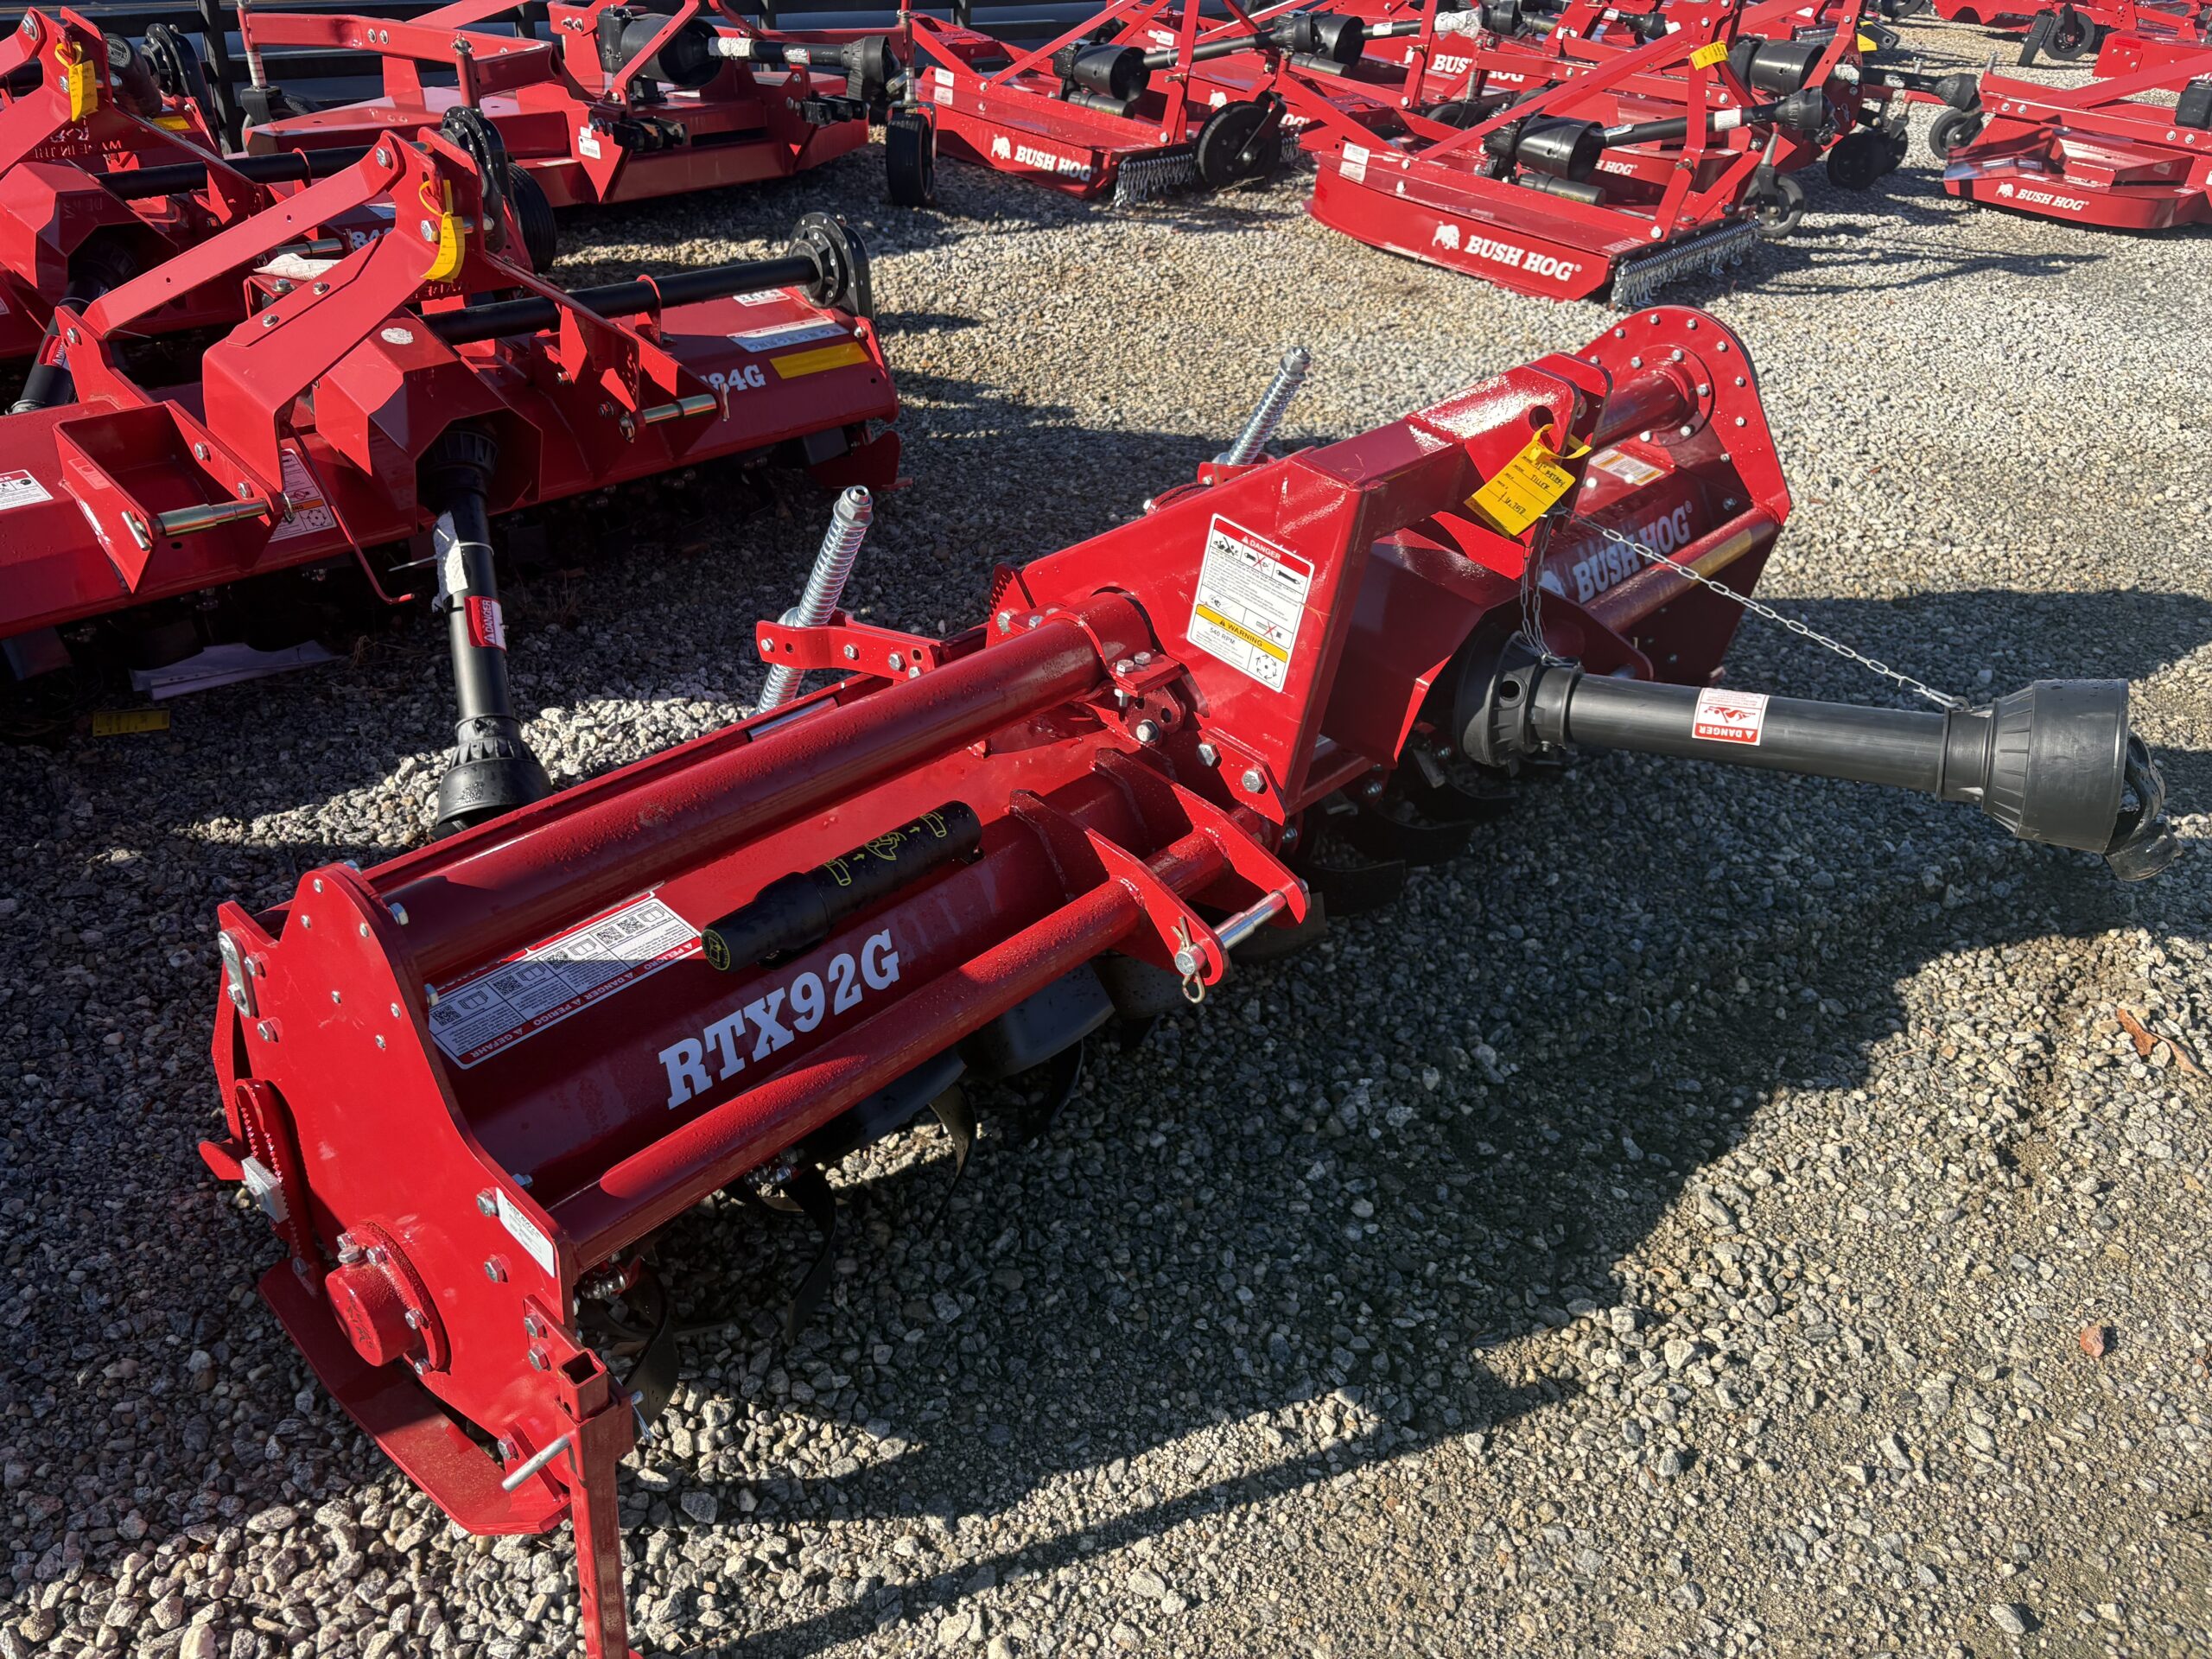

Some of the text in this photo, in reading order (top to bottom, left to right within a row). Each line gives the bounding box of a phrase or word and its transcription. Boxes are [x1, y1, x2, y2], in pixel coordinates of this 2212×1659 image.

[1432, 54, 1473, 74] BUS
[1014, 145, 1058, 172] BUSH
[2016, 188, 2054, 205] BUSH
[1464, 235, 1524, 267] BUSH
[1248, 539, 1281, 561] DANGER
[1573, 536, 1643, 603] BUSH
[481, 600, 494, 632] DANGER
[1210, 626, 1236, 645] 540 RPM
[1228, 621, 1263, 647] WARNING
[1699, 725, 1743, 739] DANGER
[644, 944, 686, 970] PELIGRO
[584, 976, 626, 1001] DANGER
[533, 1003, 573, 1027] PERIGO
[658, 928, 901, 1111] RTX92G
[469, 1030, 513, 1058] GEFAHR
